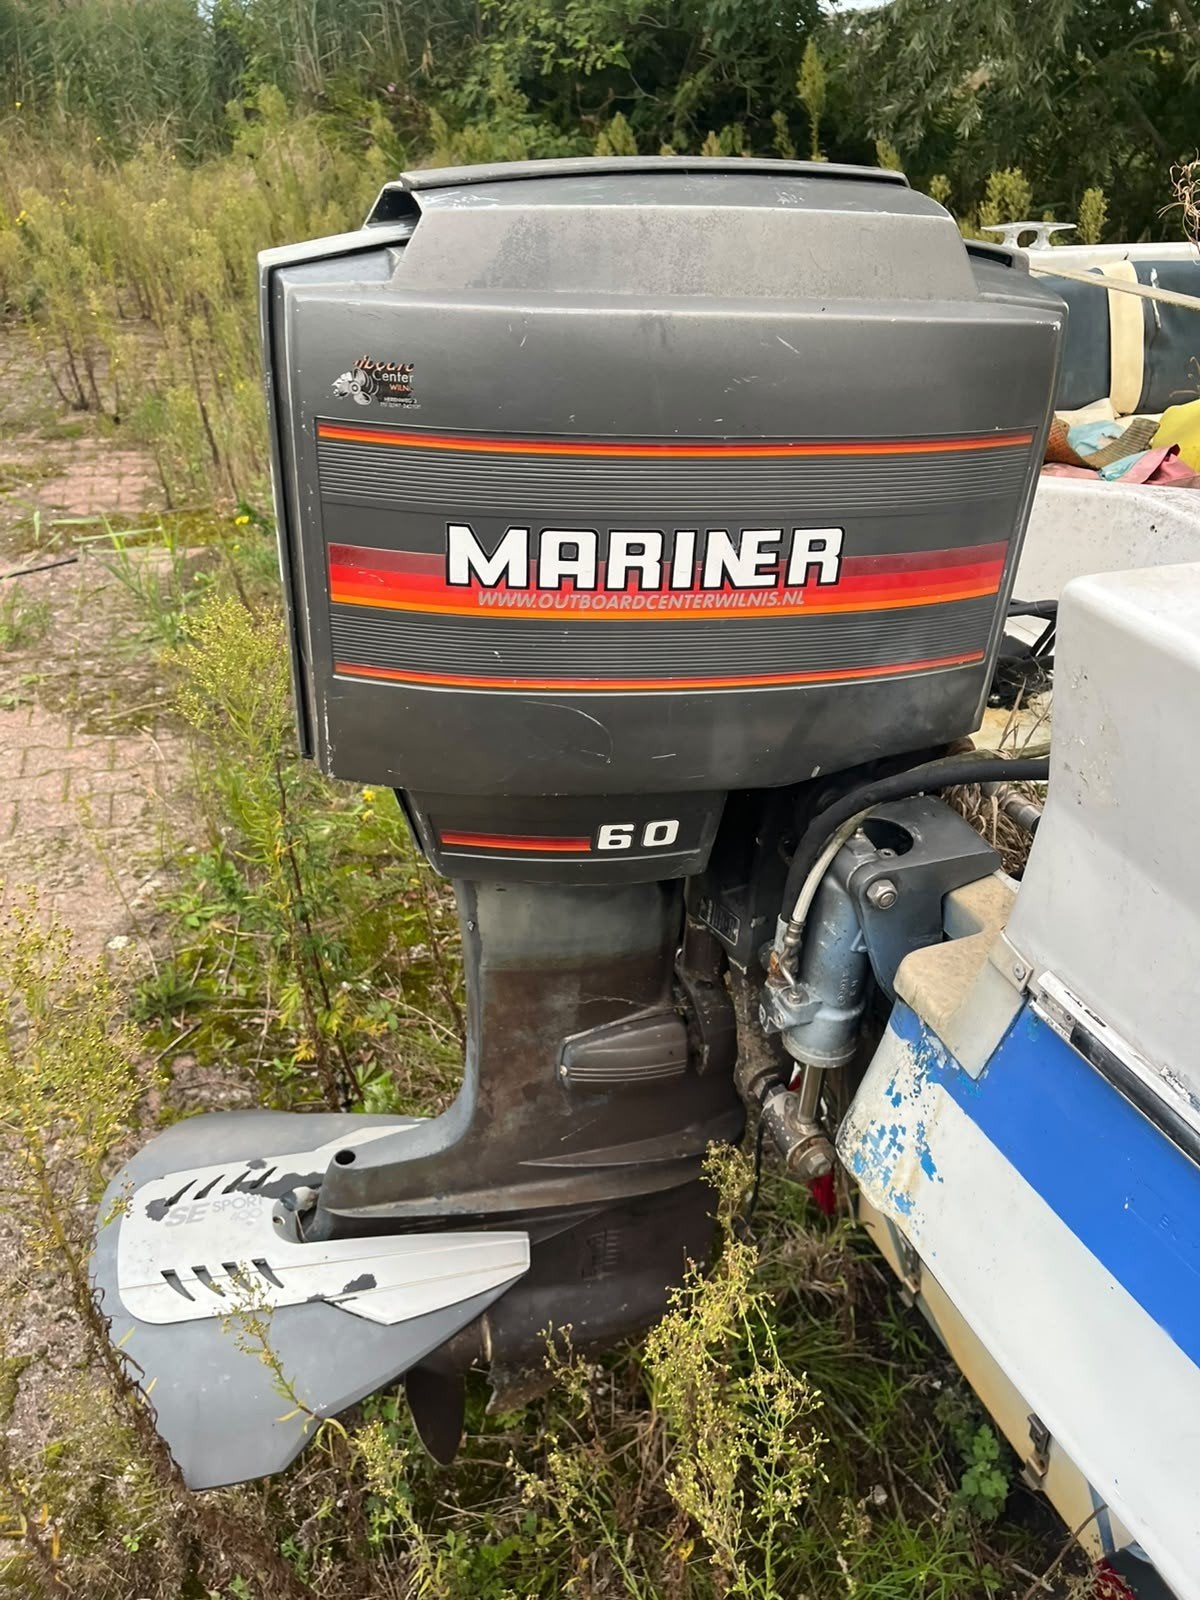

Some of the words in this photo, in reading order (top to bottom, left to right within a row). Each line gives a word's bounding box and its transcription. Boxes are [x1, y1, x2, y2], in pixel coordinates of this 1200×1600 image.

[372, 369, 414, 383] Center
[446, 523, 845, 590] MARINER
[477, 590, 805, 610] WWW.OUTBOARDCENTERWILNIS.NL
[597, 820, 680, 850] 60
[165, 1202, 211, 1227] SE
[211, 1196, 263, 1214] SPORT
